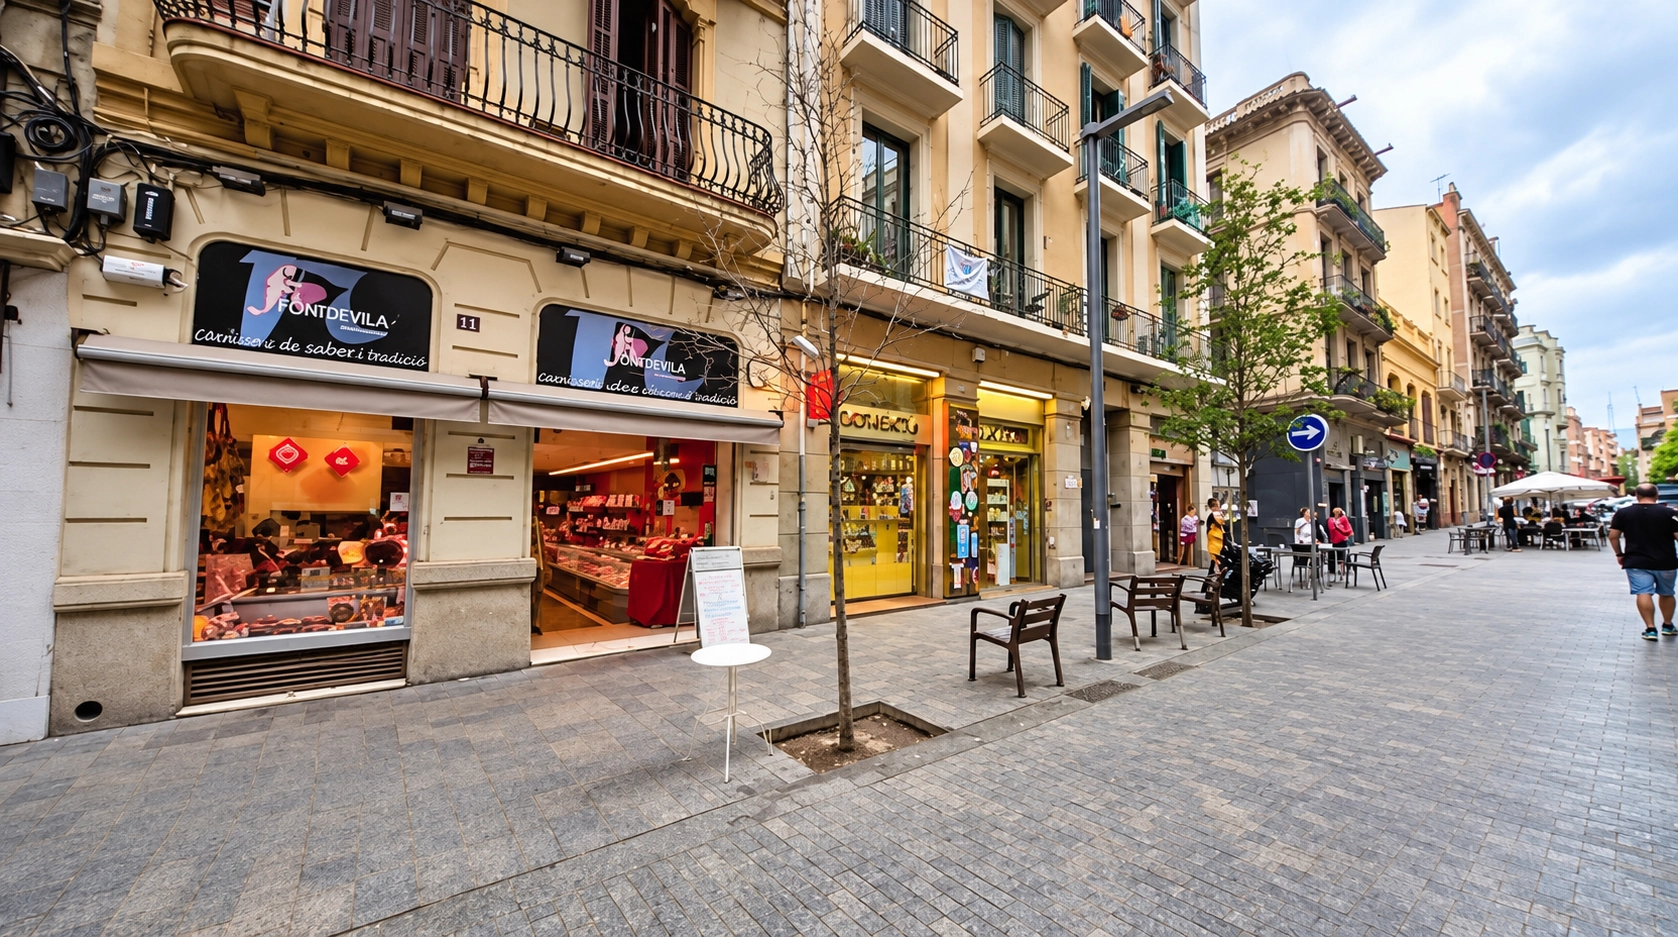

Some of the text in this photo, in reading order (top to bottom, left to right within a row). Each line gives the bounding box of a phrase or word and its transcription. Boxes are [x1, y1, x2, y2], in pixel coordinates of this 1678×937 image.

[278, 298, 390, 329] FONTDEVILA
[459, 316, 477, 331] 11
[279, 336, 300, 352] de
[304, 341, 356, 358] saber
[367, 348, 428, 367] tradició
